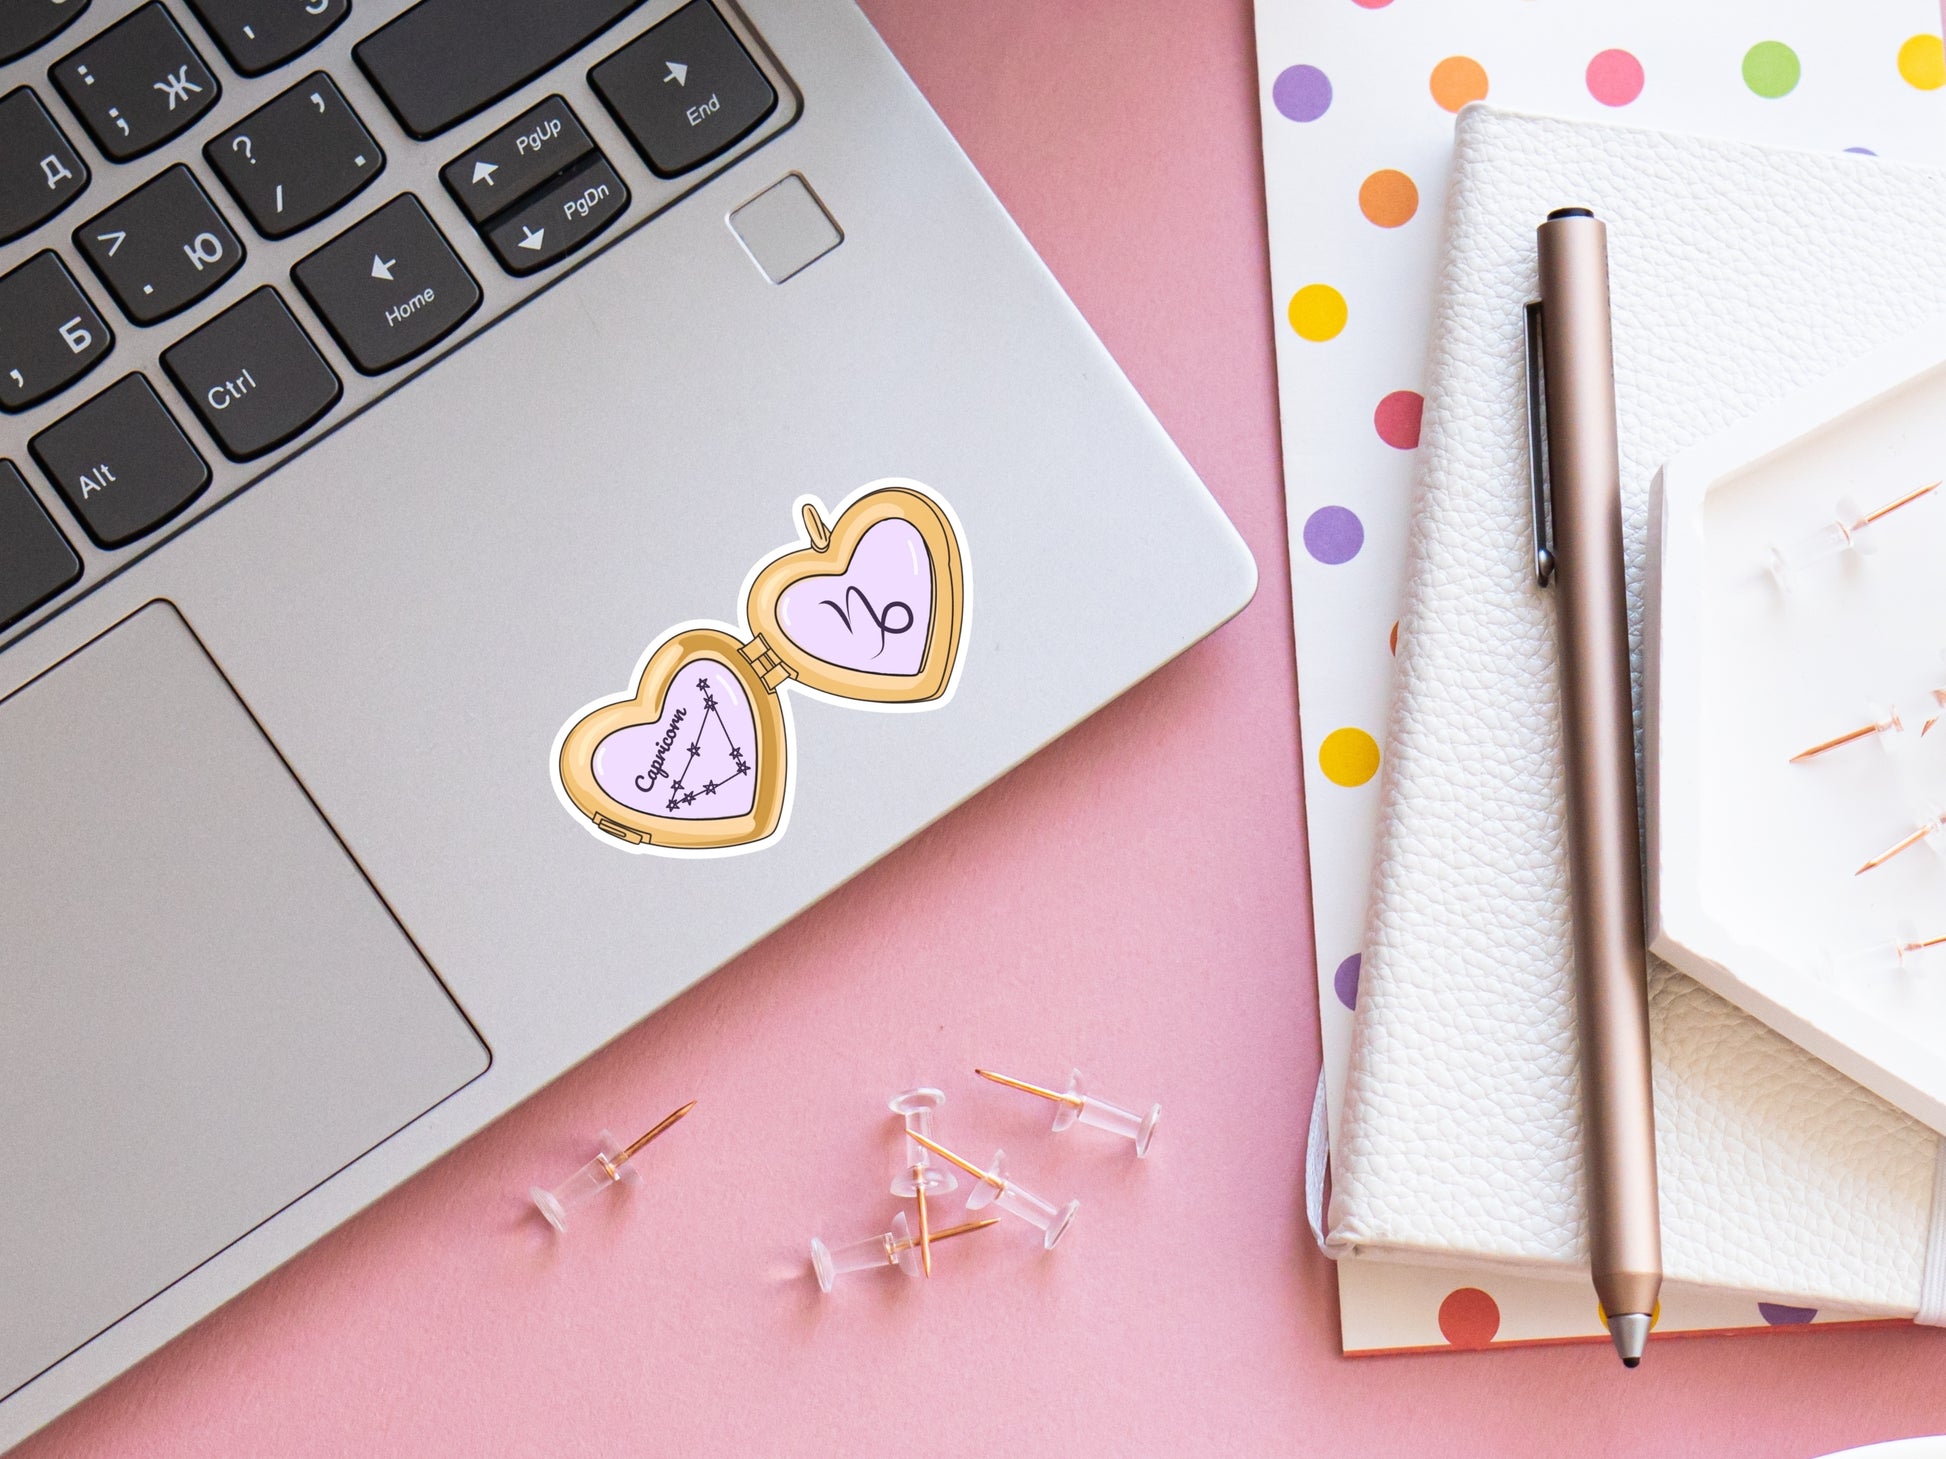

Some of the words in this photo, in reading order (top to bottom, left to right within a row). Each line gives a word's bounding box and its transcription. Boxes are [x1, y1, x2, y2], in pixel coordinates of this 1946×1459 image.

[153, 64, 203, 111] Ж
[685, 93, 721, 127] End
[232, 135, 257, 165] ?
[515, 117, 562, 156] PgUp
[39, 154, 73, 190] Д
[563, 183, 610, 221] PgDn
[183, 232, 223, 271] Ю
[384, 287, 436, 327] Home
[58, 316, 92, 354] Б
[207, 368, 257, 410] Ctrl
[79, 463, 117, 500] Alt
[634, 707, 687, 793] Capricorn
